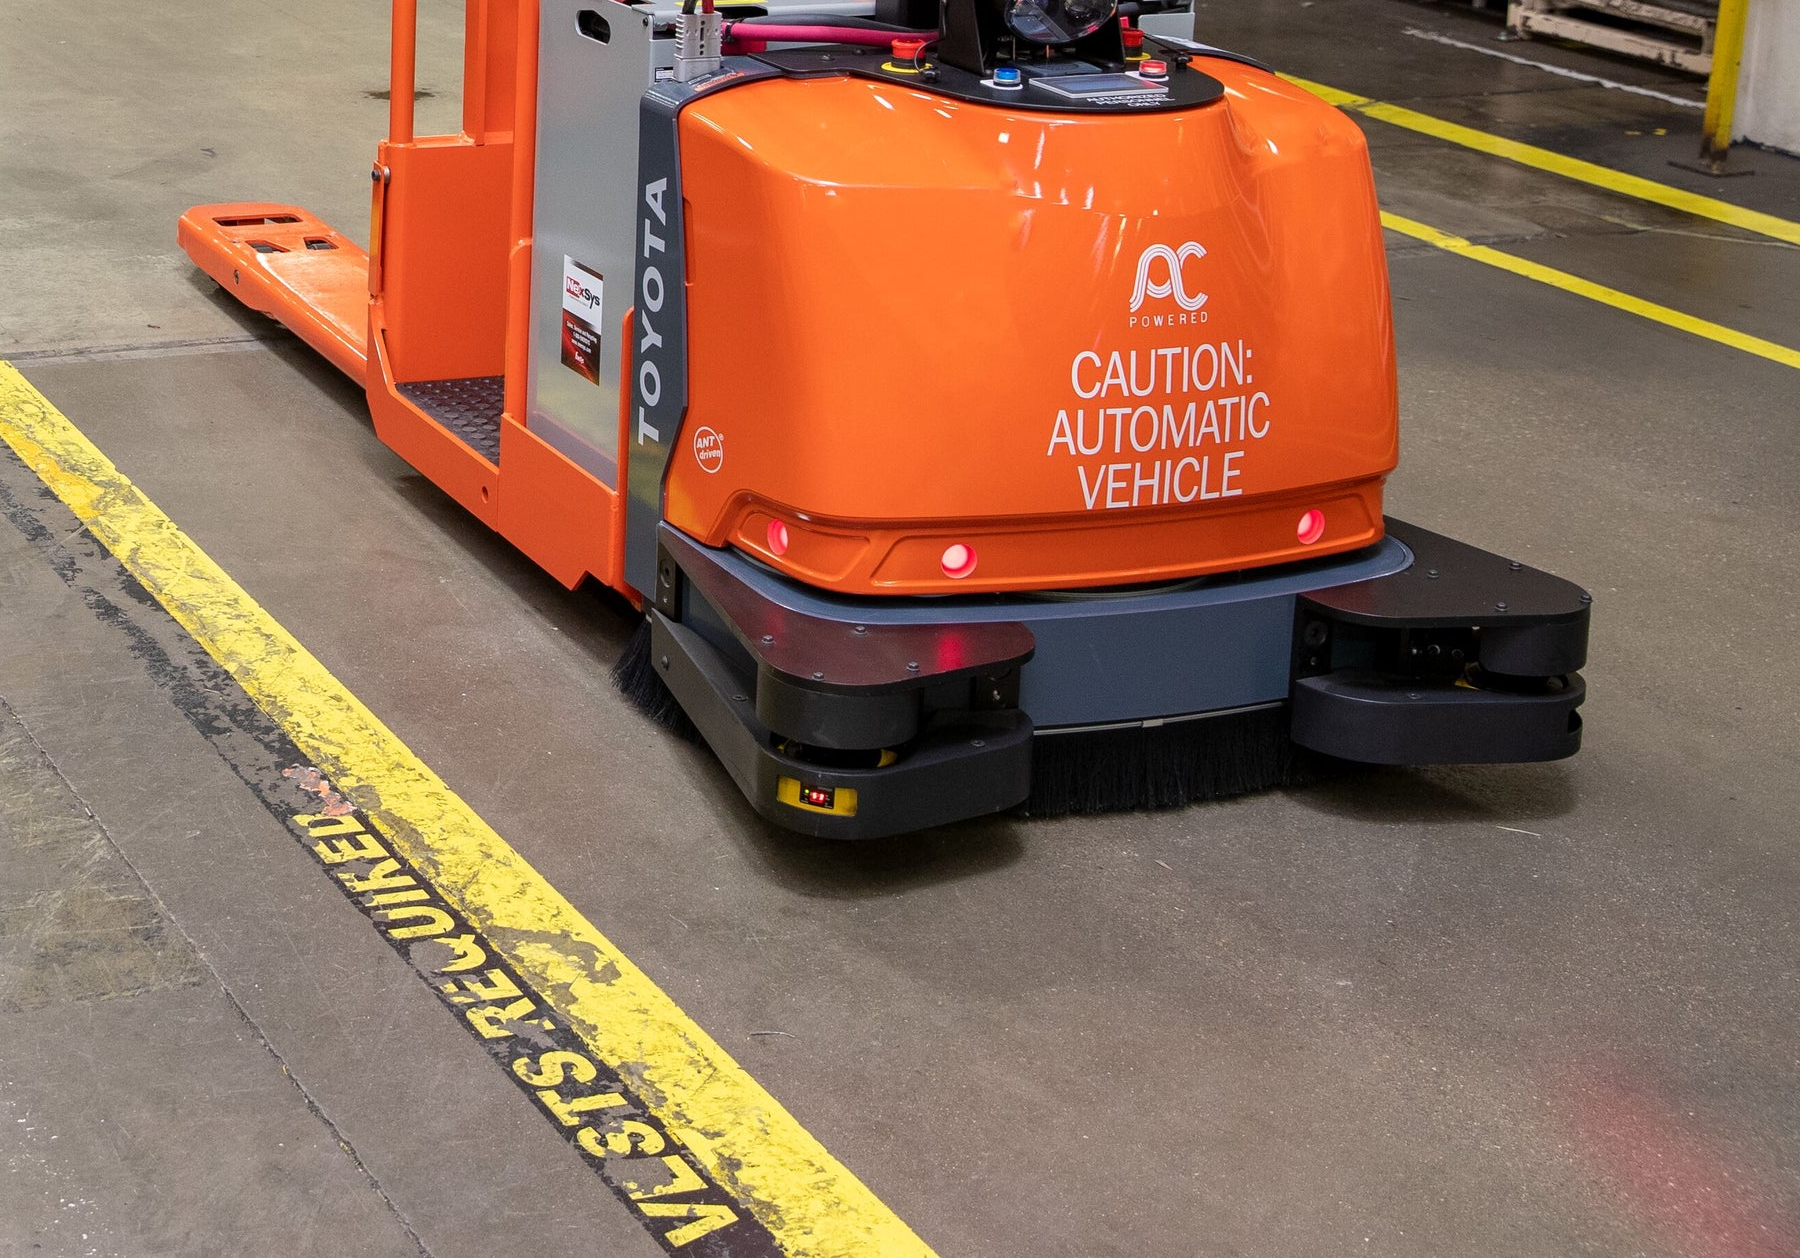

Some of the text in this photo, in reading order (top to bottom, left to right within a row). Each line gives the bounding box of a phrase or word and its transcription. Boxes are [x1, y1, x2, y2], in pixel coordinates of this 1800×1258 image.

[566, 277, 601, 309] NexSys
[638, 177, 667, 446] TOYOTA
[1129, 311, 1208, 328] POWERED
[1071, 339, 1252, 399] CAUTION:
[696, 435, 715, 449] ANT
[1047, 391, 1270, 456] AUTOMATIC
[699, 449, 721, 460] driven
[1077, 450, 1245, 510] VEHICLE
